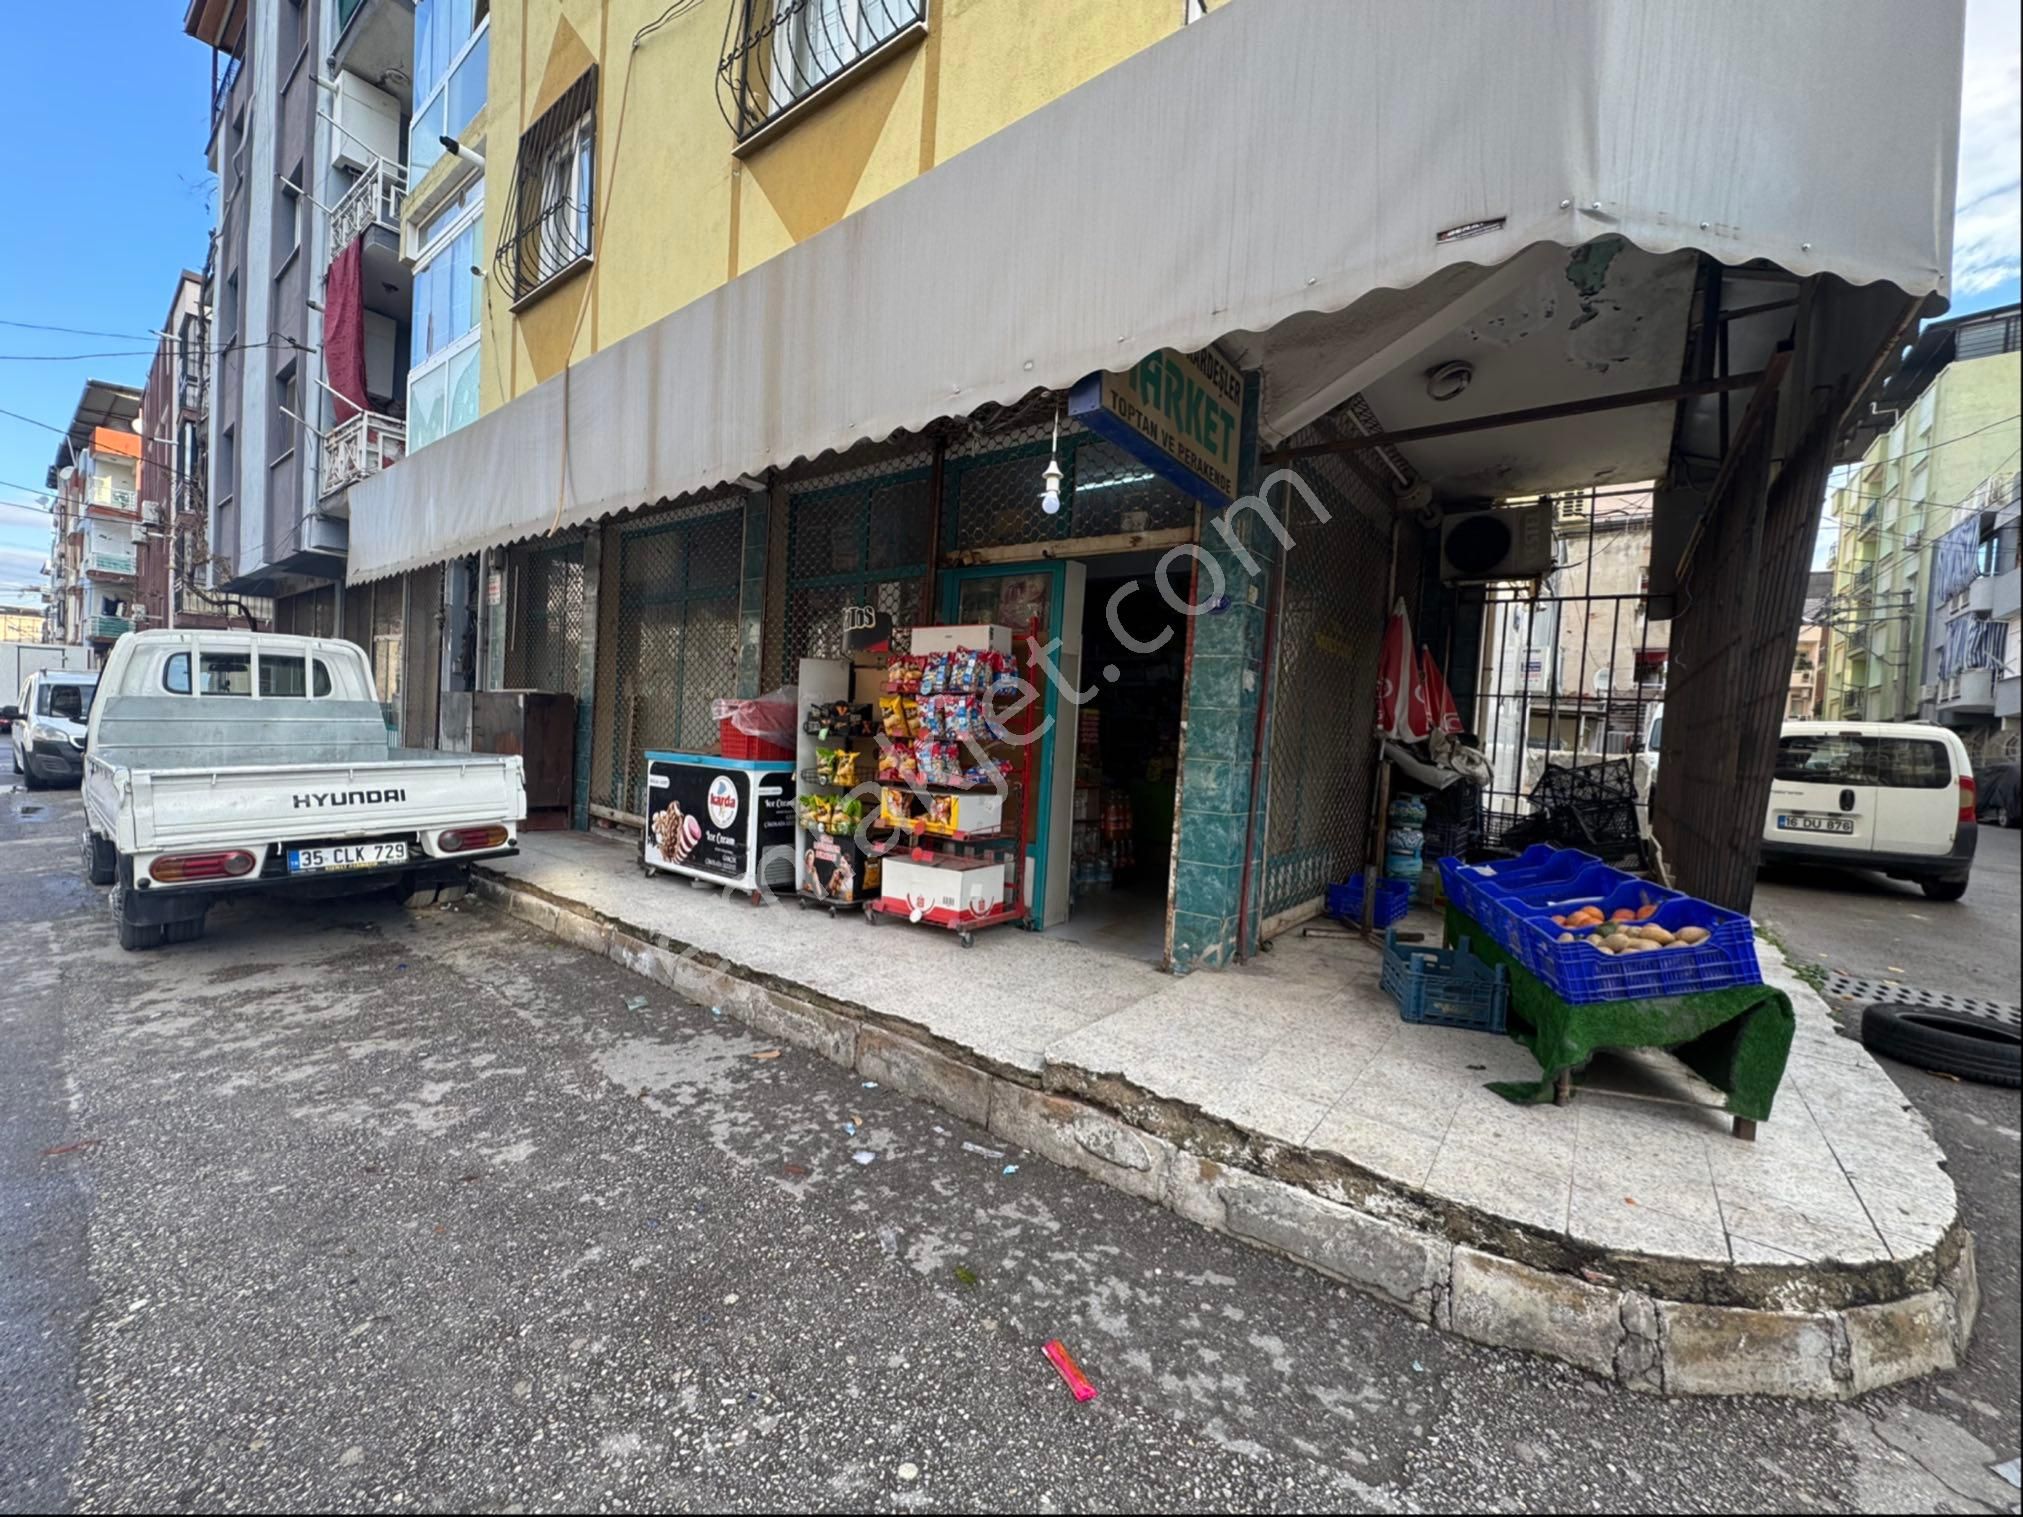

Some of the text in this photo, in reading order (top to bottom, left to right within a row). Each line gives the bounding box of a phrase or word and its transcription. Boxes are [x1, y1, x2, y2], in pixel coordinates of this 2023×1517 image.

[1111, 390, 1232, 495] TOPTAN VE PERAKENDE
[293, 789, 406, 808] HYUNDAI
[1786, 817, 1850, 831] 16 DU 876
[301, 850, 324, 867] 35
[333, 846, 365, 864] CLK
[374, 843, 405, 861] 729
